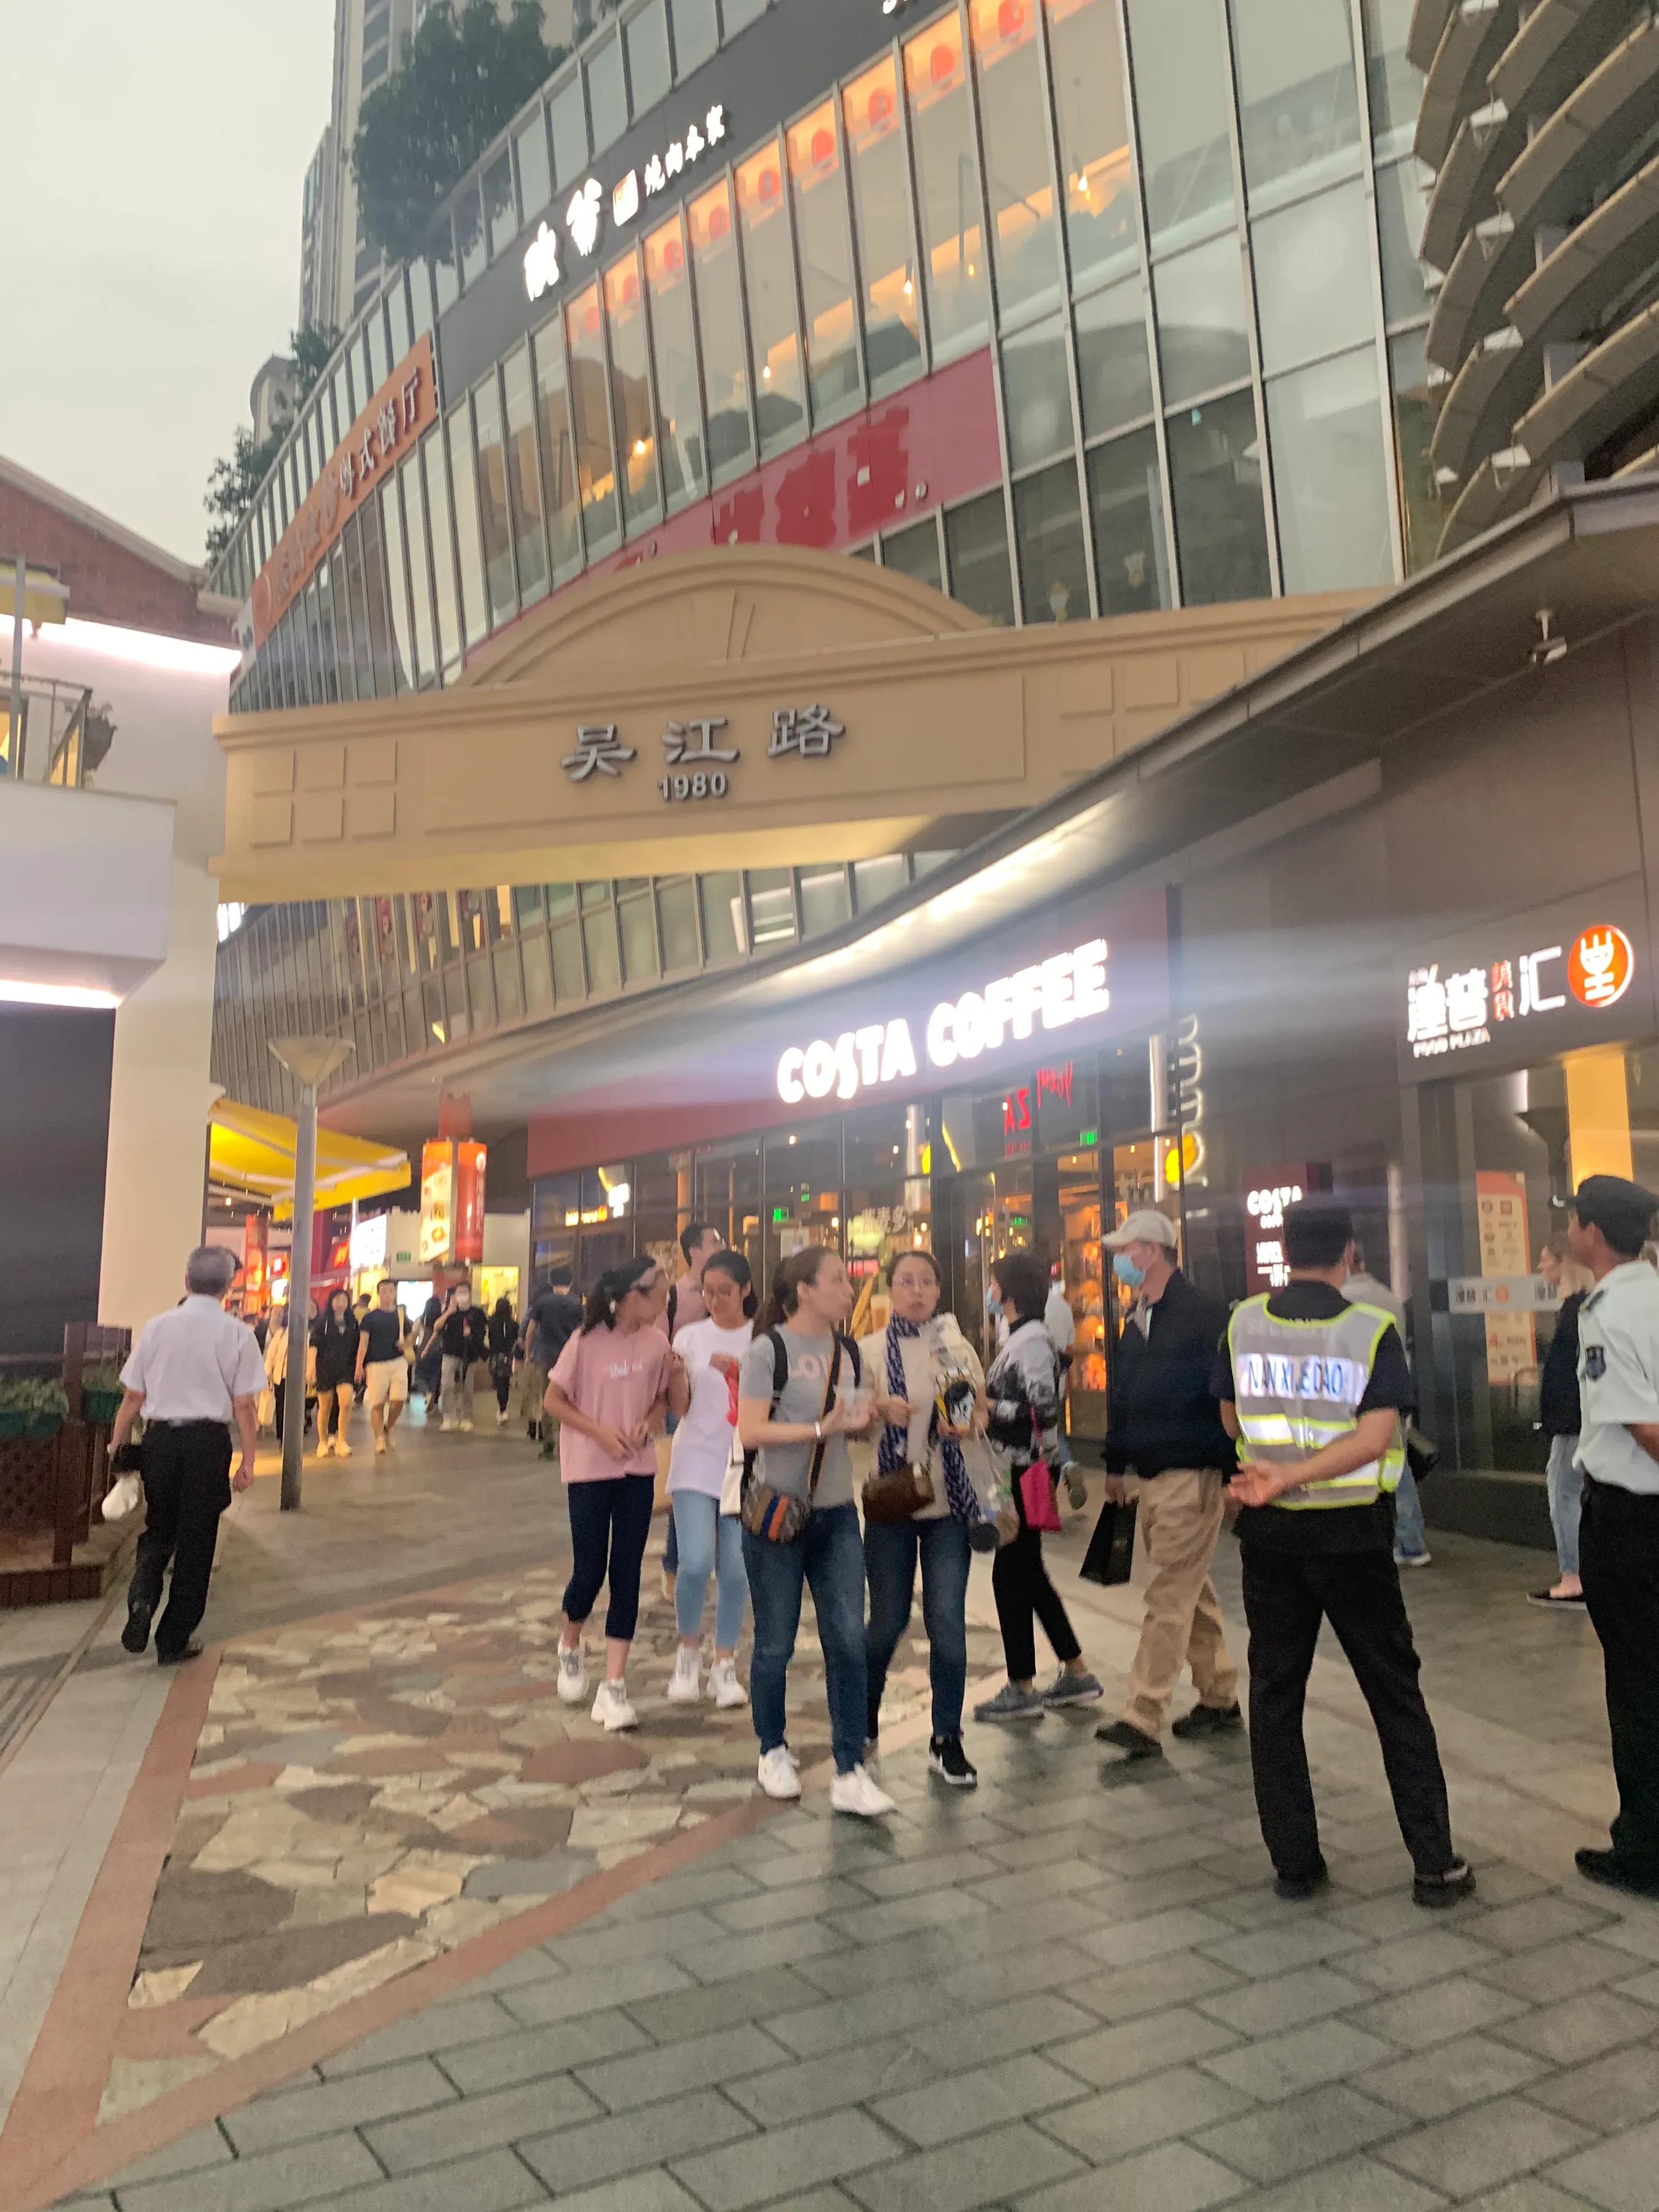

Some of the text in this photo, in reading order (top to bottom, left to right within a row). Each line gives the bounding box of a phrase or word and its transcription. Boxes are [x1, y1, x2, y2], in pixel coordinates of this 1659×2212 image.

[560, 703, 847, 782] 吴江路
[658, 772, 729, 801] 1980
[777, 1018, 917, 1104] COSTA
[926, 938, 1110, 1067] COFFEE
